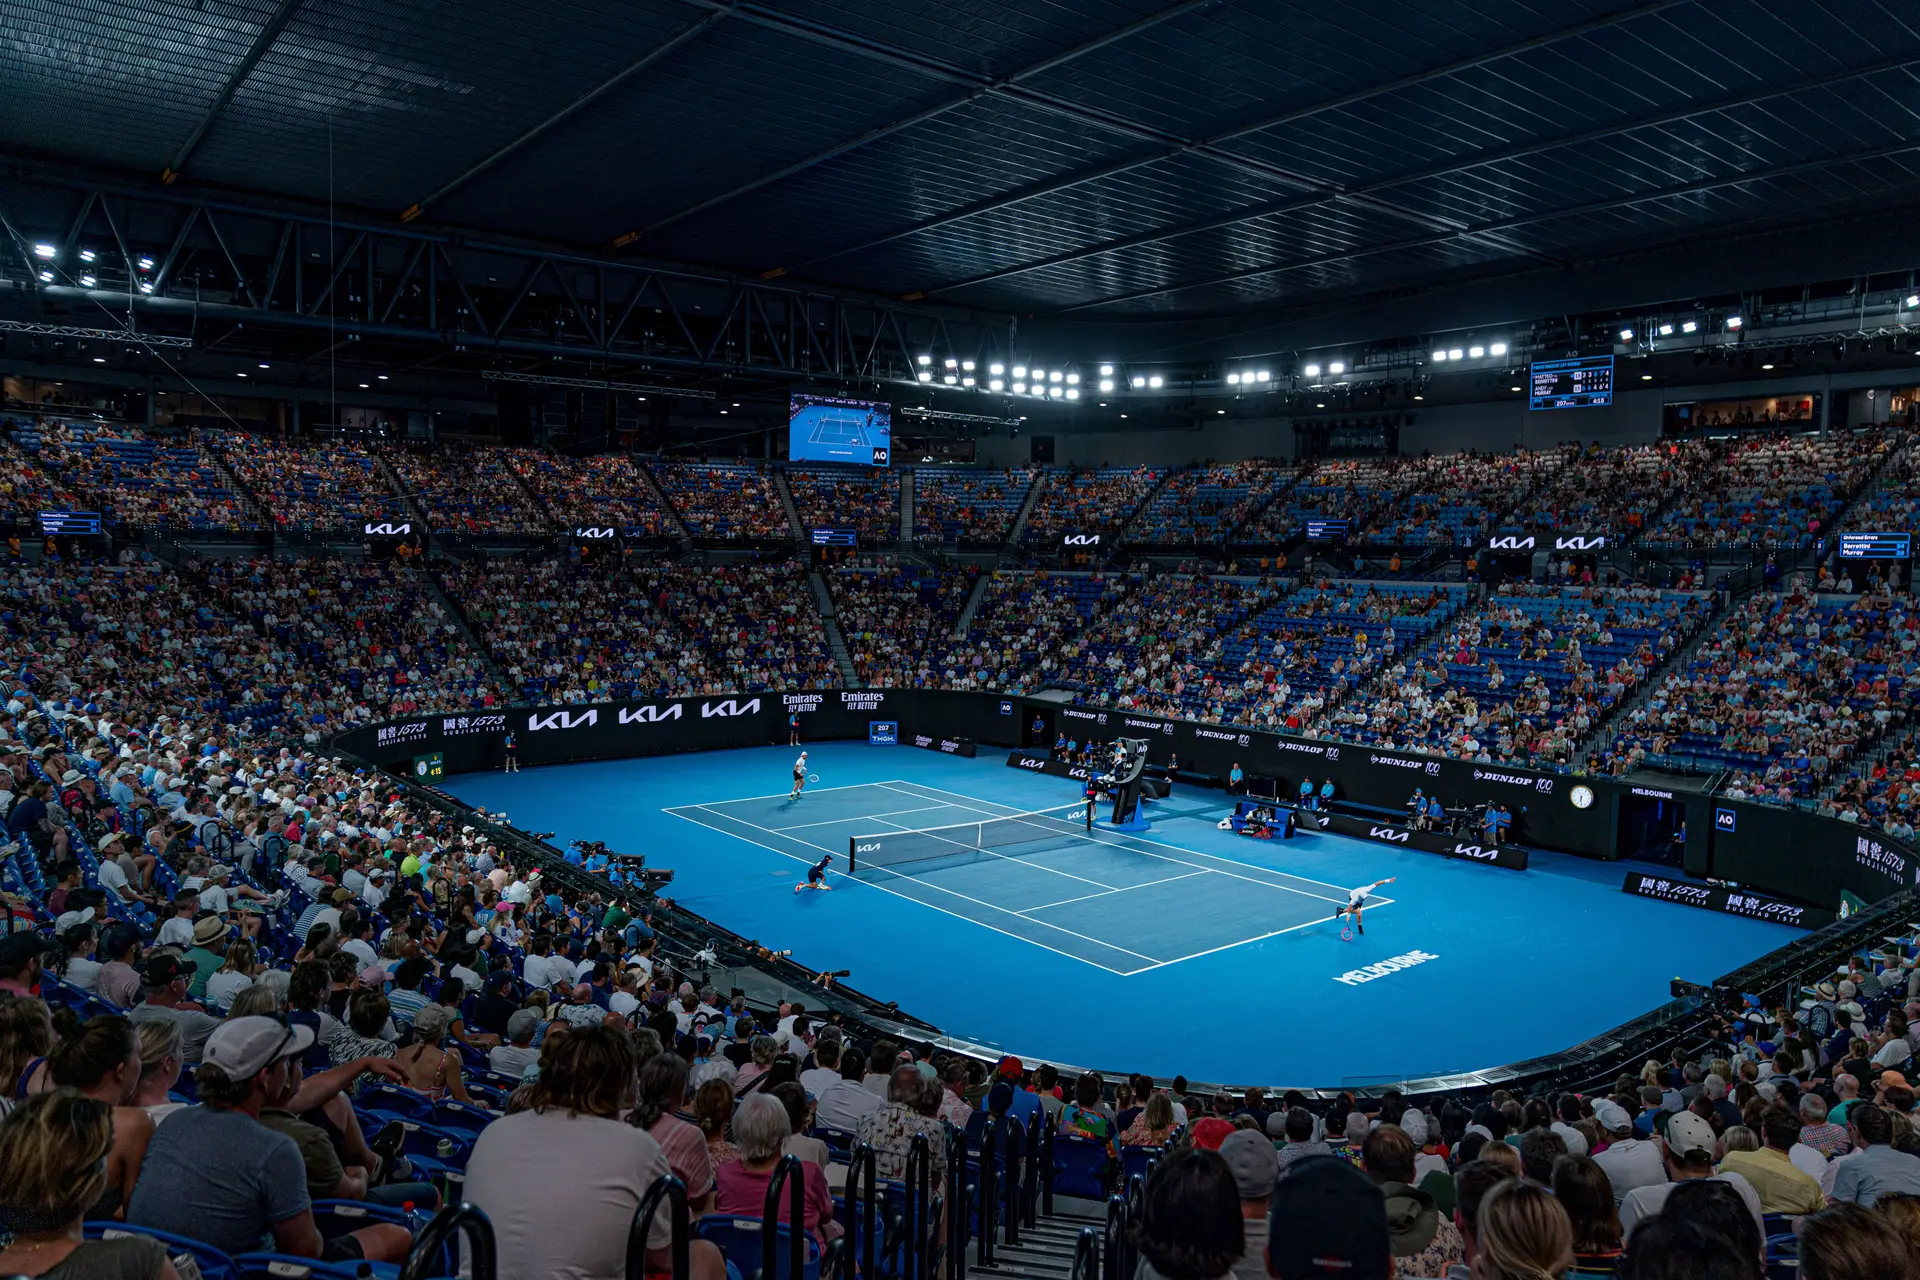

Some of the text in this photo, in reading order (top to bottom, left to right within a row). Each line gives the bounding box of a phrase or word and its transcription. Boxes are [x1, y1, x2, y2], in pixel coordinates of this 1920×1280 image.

[874, 451, 886, 460] AO
[783, 694, 823, 704] Emirates
[841, 692, 884, 702] Emirates
[798, 704, 817, 712] BETTER
[847, 702, 878, 710] FLY BETTER
[1068, 711, 1096, 719] DUNLOP
[1131, 720, 1161, 729] DUNLOP
[443, 728, 479, 736] GUOJIAO
[1202, 731, 1250, 744] DUNLOP 100
[1285, 743, 1340, 758] DUNLOP 100
[1378, 757, 1441, 773] DUNLOP 100
[1483, 772, 1553, 791] DUNLOP 100
[1632, 787, 1672, 799] MELBOURNE
[1718, 814, 1733, 825] AO
[1639, 888, 1678, 900] GUOJIAO
[1726, 905, 1800, 924] GUOJIAO 1573
[1332, 950, 1439, 986] MELBOURNE
